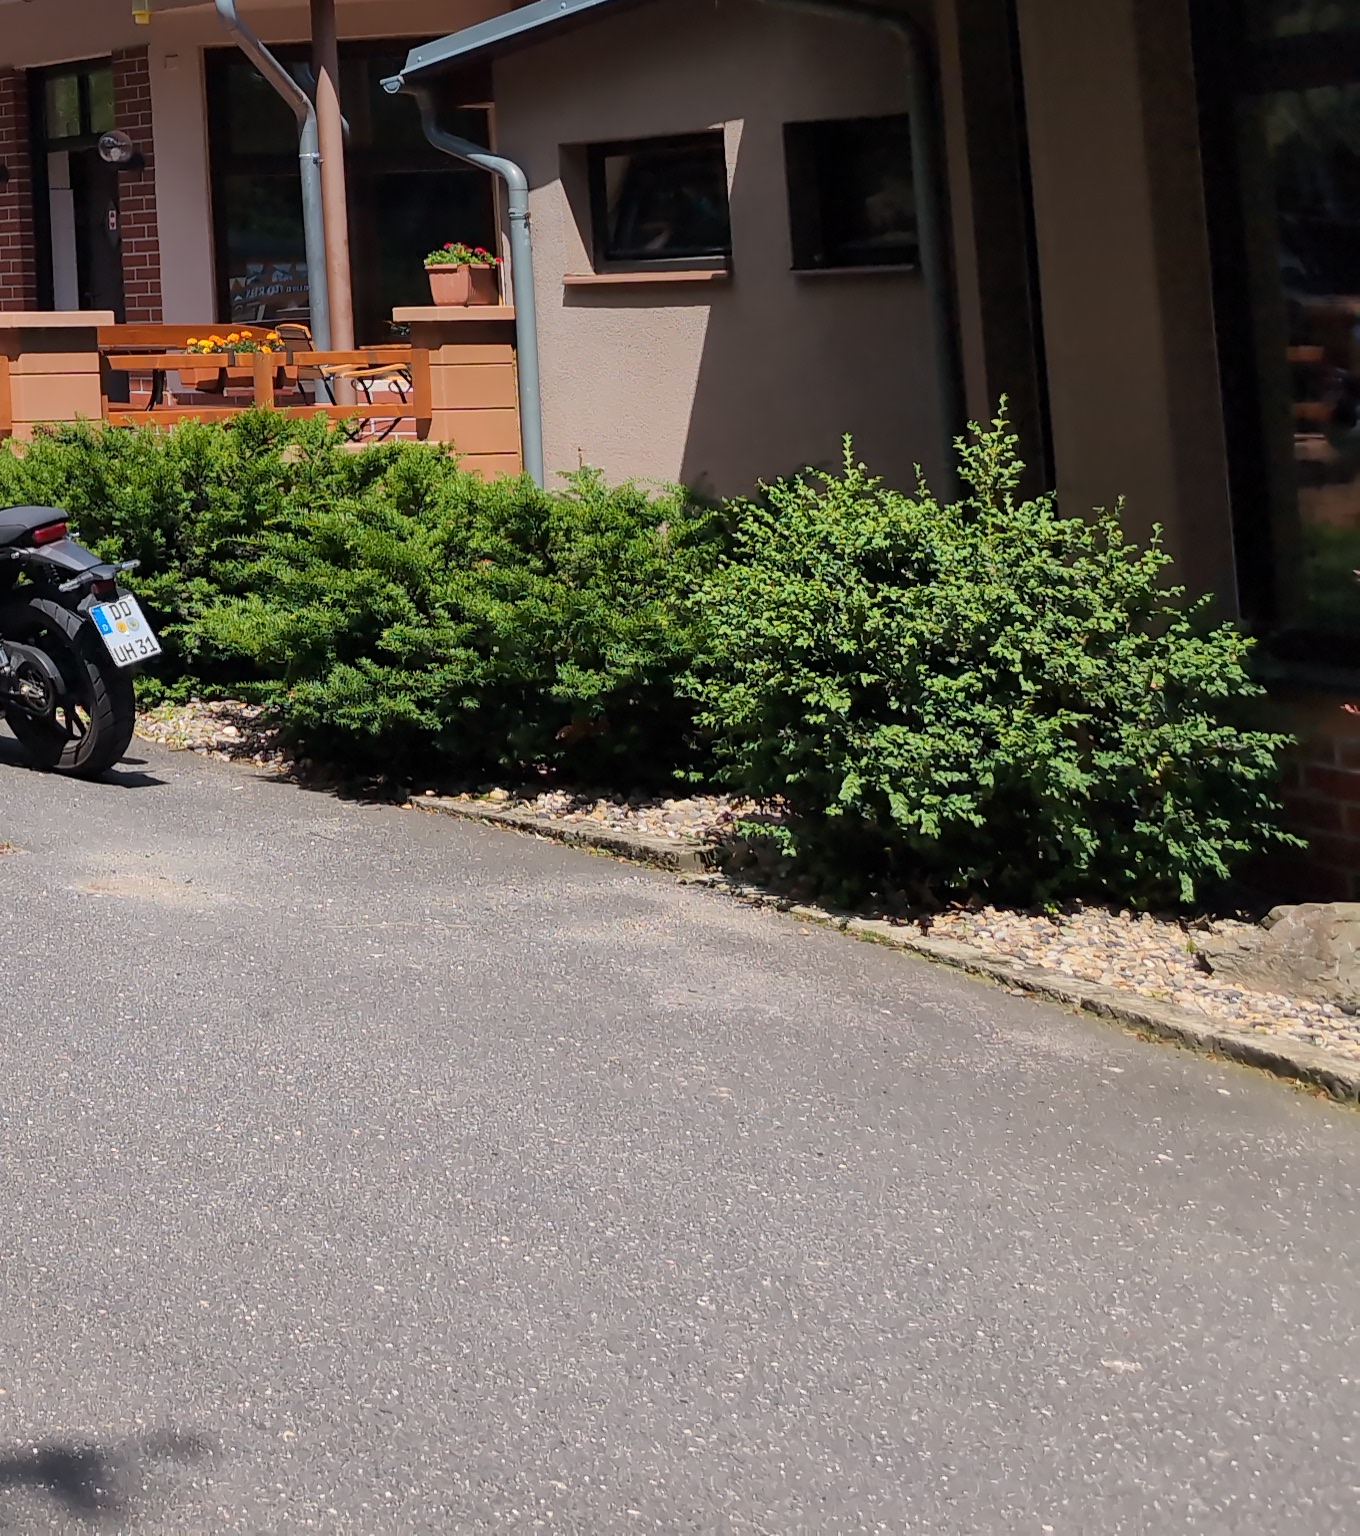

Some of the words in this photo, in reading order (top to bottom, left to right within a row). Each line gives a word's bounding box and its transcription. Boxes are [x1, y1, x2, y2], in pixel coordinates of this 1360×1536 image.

[109, 601, 132, 621] DD
[101, 623, 109, 632] D
[113, 643, 138, 663] UH
[135, 636, 158, 655] 31
